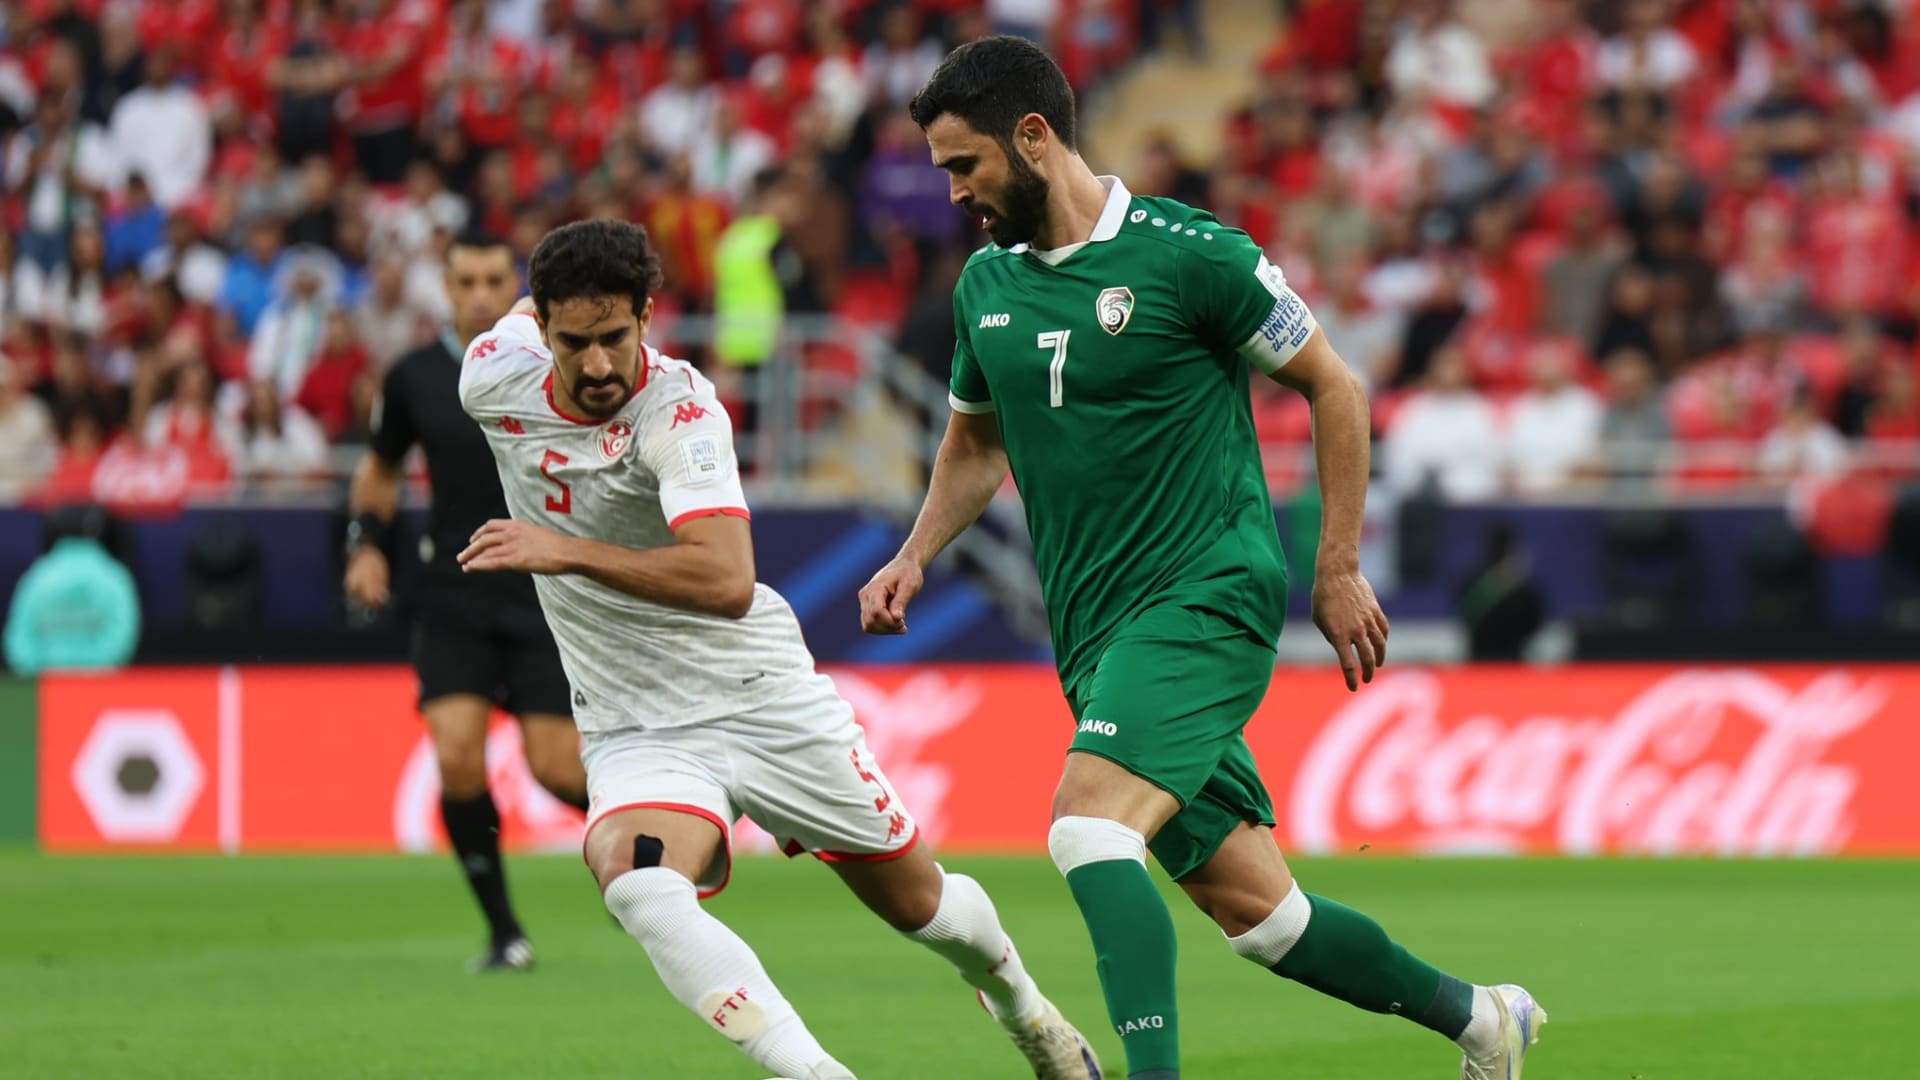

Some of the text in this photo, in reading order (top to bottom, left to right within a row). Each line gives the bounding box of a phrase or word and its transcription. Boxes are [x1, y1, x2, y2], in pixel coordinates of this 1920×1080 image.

[979, 313, 1010, 328] JAKO
[1260, 291, 1291, 333] FOOTBALL
[1264, 296, 1301, 341] UNITES
[1271, 335, 1289, 353] the
[1037, 329, 1071, 408] 7
[540, 448, 571, 514] 5
[1078, 719, 1117, 736] JAKO
[849, 748, 890, 813] 5
[713, 987, 748, 1028] FTF
[1118, 1015, 1163, 1036] JAKO
